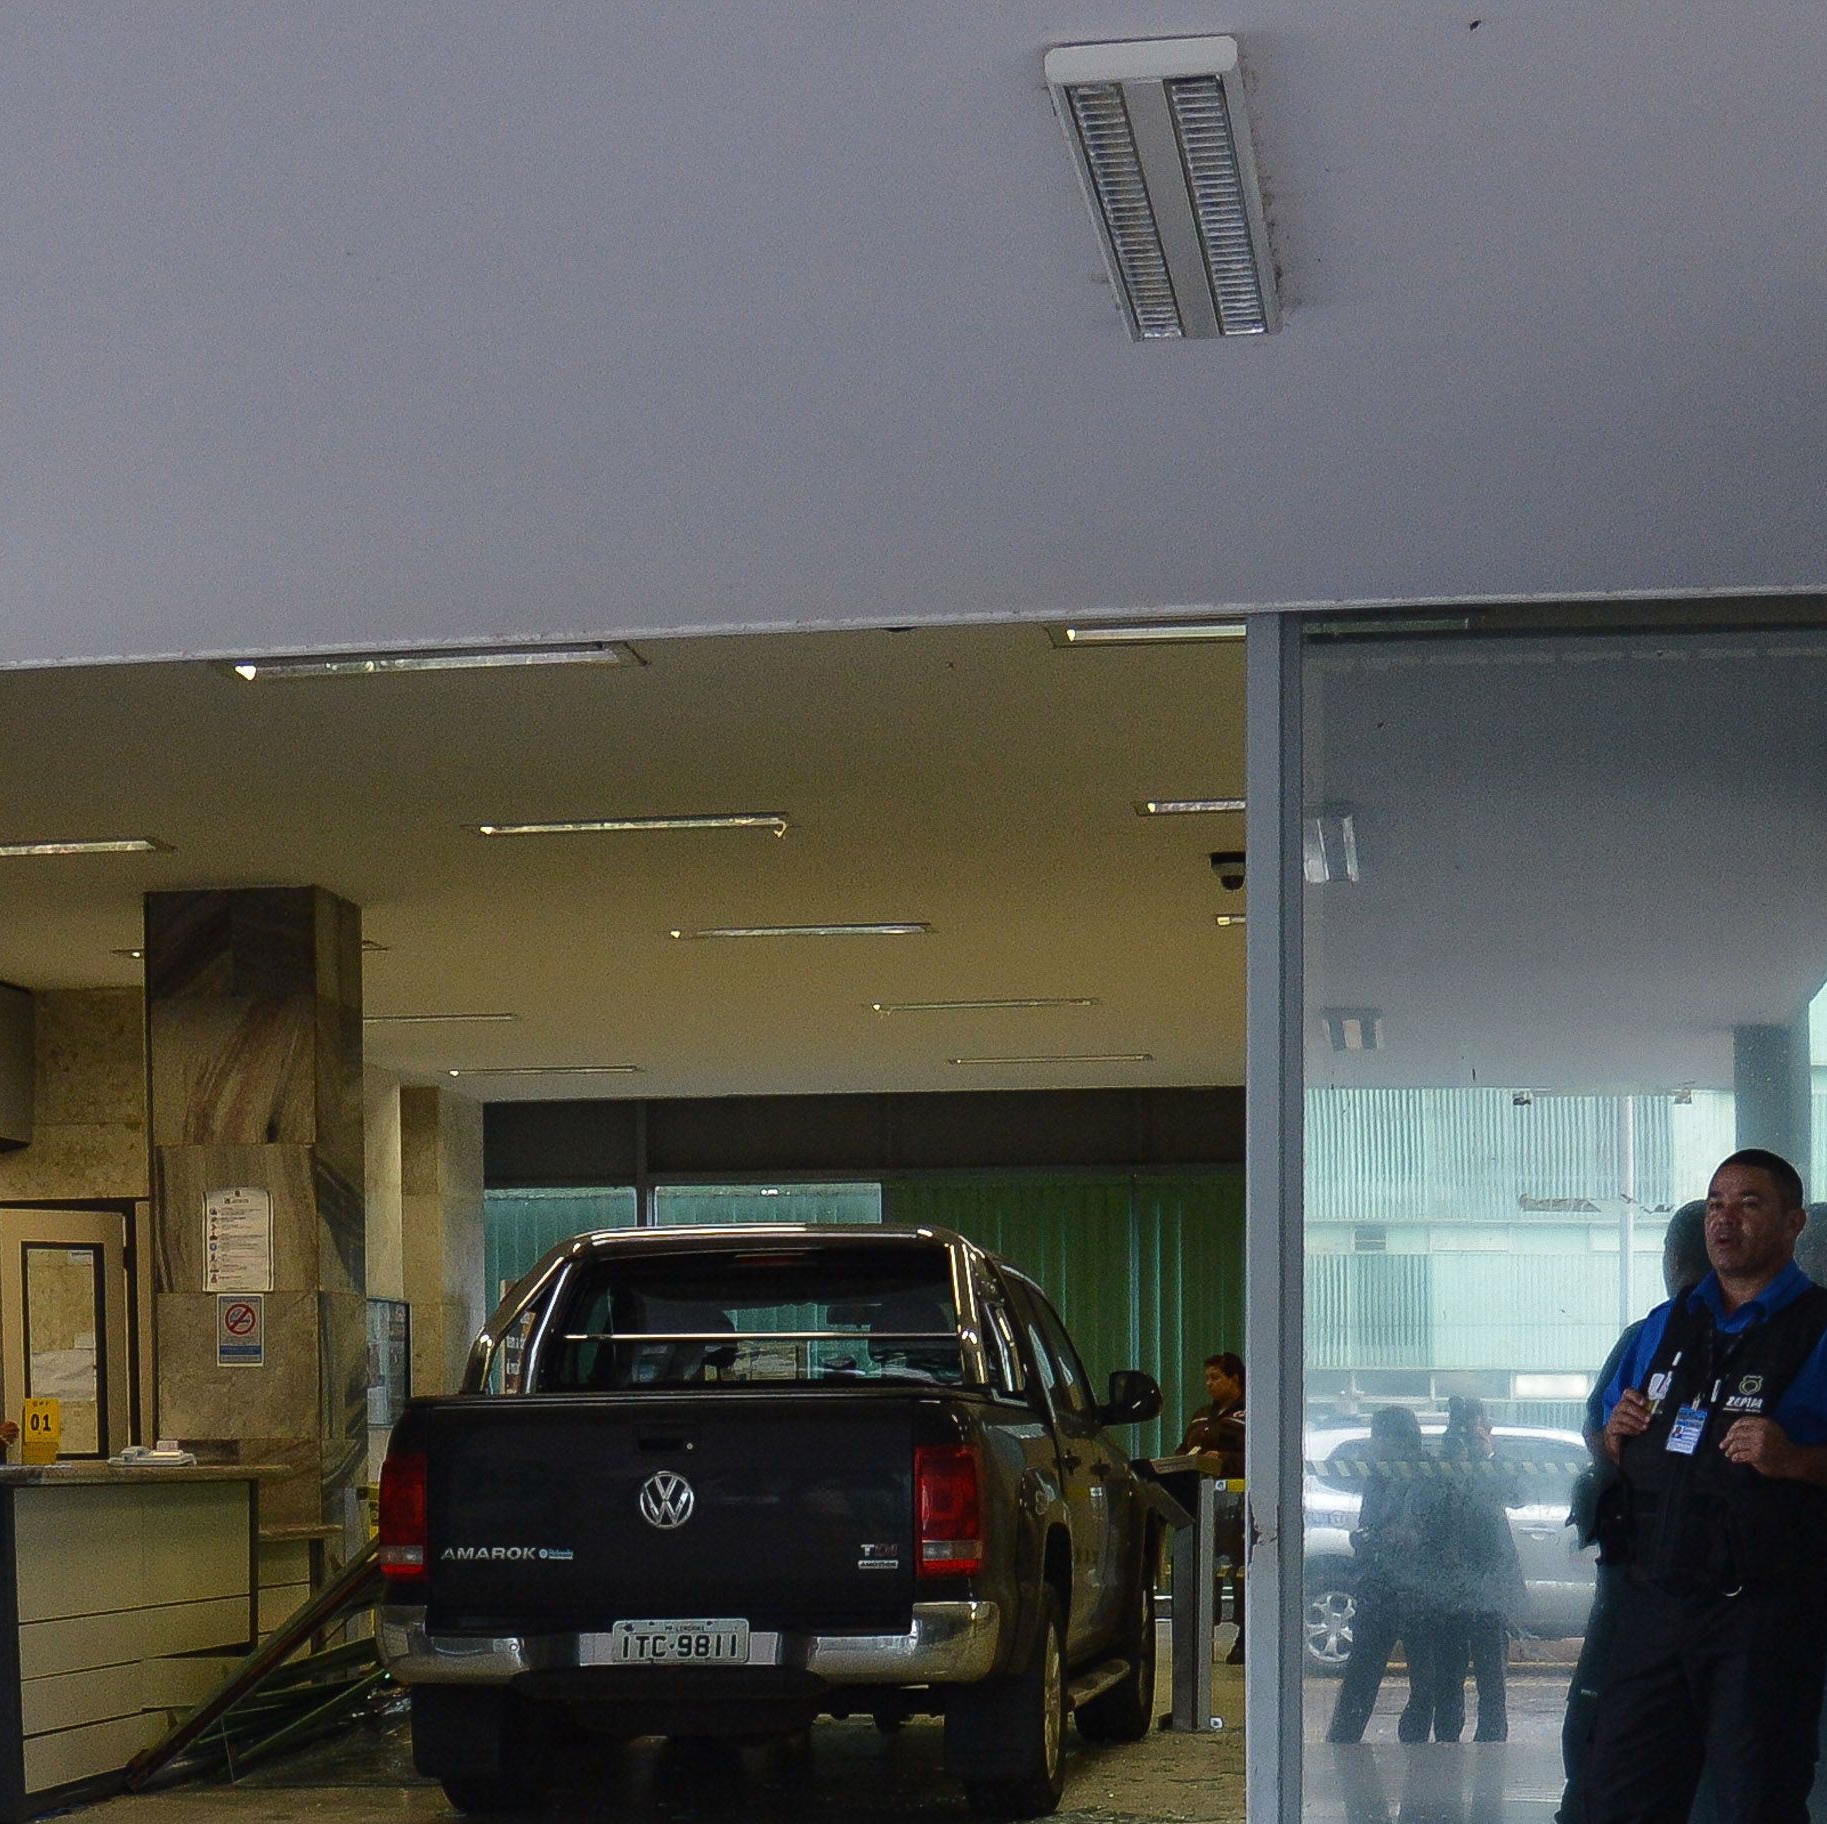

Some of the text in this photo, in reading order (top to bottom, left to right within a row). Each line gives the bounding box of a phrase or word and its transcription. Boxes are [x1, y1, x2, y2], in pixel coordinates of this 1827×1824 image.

[31, 1413, 52, 1431] 01
[441, 1547, 536, 1560] AMAROK
[677, 1634, 737, 1657] 9811
